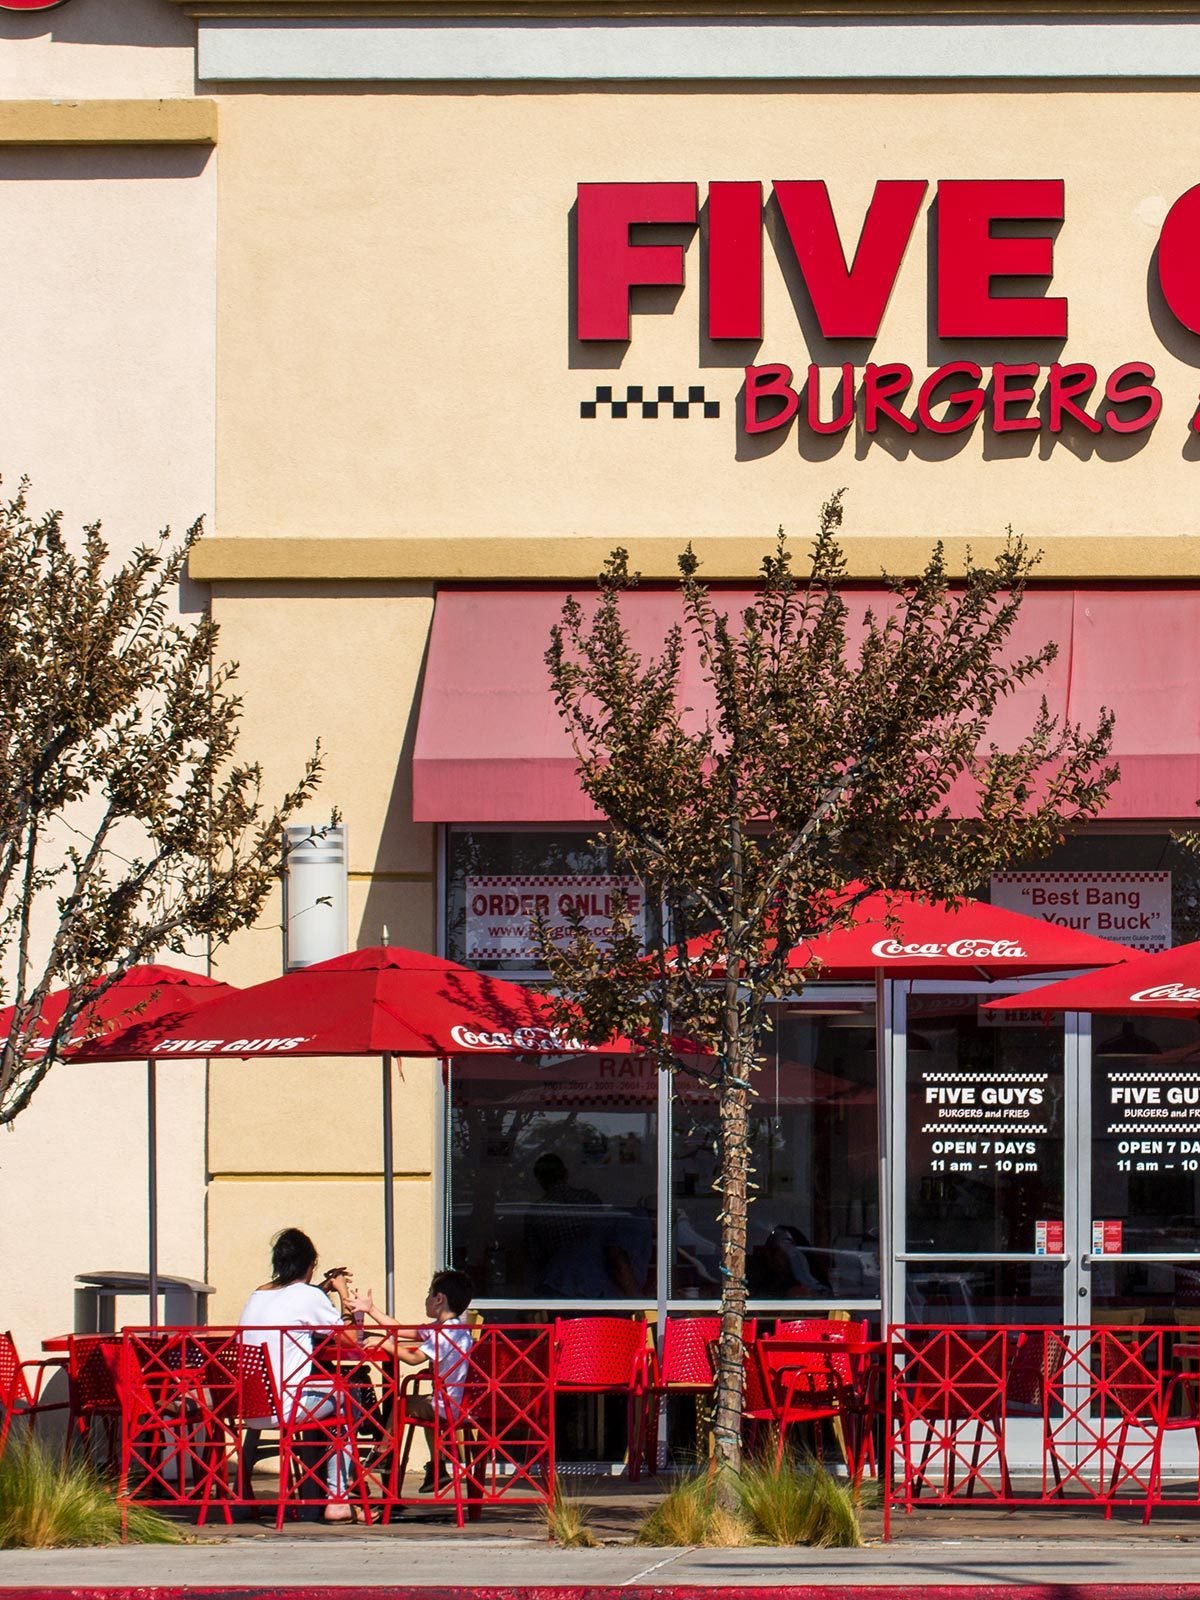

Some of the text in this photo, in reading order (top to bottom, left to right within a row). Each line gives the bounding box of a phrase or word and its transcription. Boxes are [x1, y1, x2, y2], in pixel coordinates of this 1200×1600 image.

[576, 178, 1068, 341] FIVE
[743, 360, 1163, 435] BURGERS
[471, 894, 641, 916] ORDER ONLIE
[1086, 887, 1141, 910] Bang
[1042, 912, 1091, 930] Your
[871, 938, 1028, 959] Coca-Cola
[152, 1036, 306, 1052] FIVE GUYS
[925, 1087, 1044, 1104] FIVE GUYS
[1111, 1087, 1161, 1104] FIVE
[938, 1109, 1030, 1118] BURGERS and FRIES
[1124, 1108, 1168, 1118] BURGERS
[1170, 1108, 1187, 1118] and
[931, 1141, 1036, 1154] OPEN 7 DAYS
[1118, 1141, 1163, 1154] OPEN
[1166, 1142, 1177, 1153] 7
[930, 1160, 945, 1171] 11
[950, 1161, 972, 1171] am
[995, 1160, 1012, 1171] 10
[1015, 1161, 1038, 1174] pm
[1117, 1160, 1131, 1171] 11
[1136, 1161, 1159, 1171] am
[1181, 1160, 1198, 1171] 10
